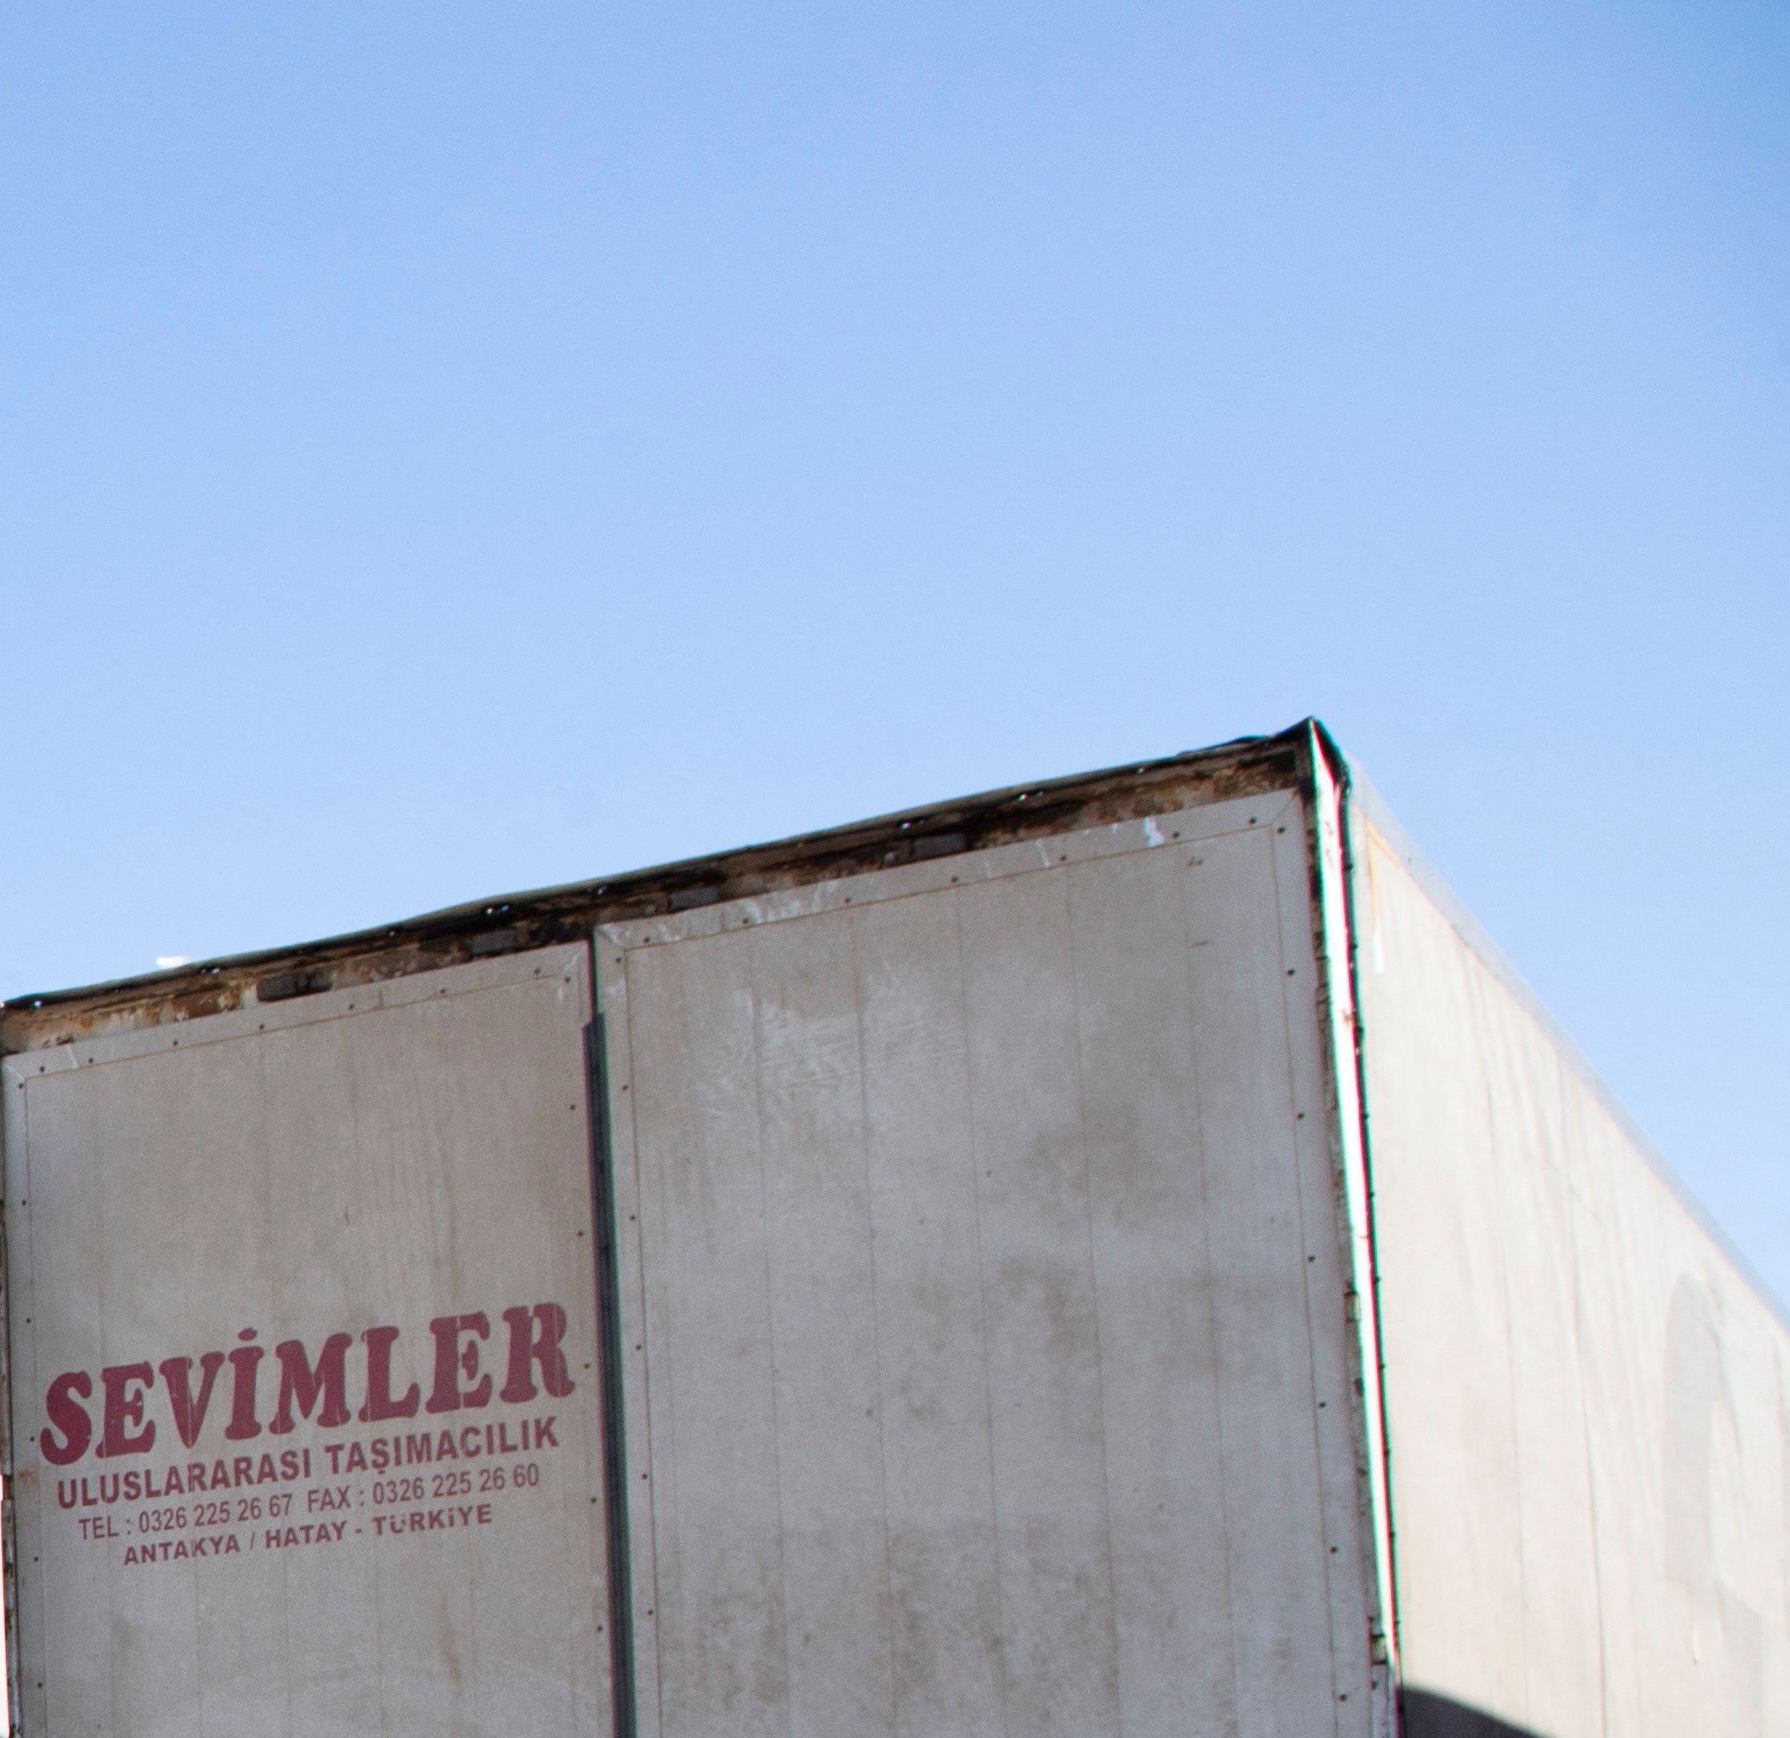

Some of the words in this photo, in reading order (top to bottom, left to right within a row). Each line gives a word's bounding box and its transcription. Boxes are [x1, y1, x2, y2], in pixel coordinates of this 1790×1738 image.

[40, 1302, 576, 1466] SEVİMLER
[57, 1448, 313, 1510] ULUSLARARASI
[325, 1416, 560, 1475] TAŞIMACILIK
[138, 1504, 189, 1535] 0326
[194, 1500, 232, 1529] 225
[238, 1497, 264, 1523] 26
[269, 1493, 293, 1520] 67
[373, 1477, 425, 1507] 0326
[431, 1470, 474, 1500] 225
[479, 1466, 507, 1494] 26
[512, 1463, 540, 1488] 60
[123, 1531, 242, 1566] ANTAKYA
[266, 1520, 348, 1549] HATAY
